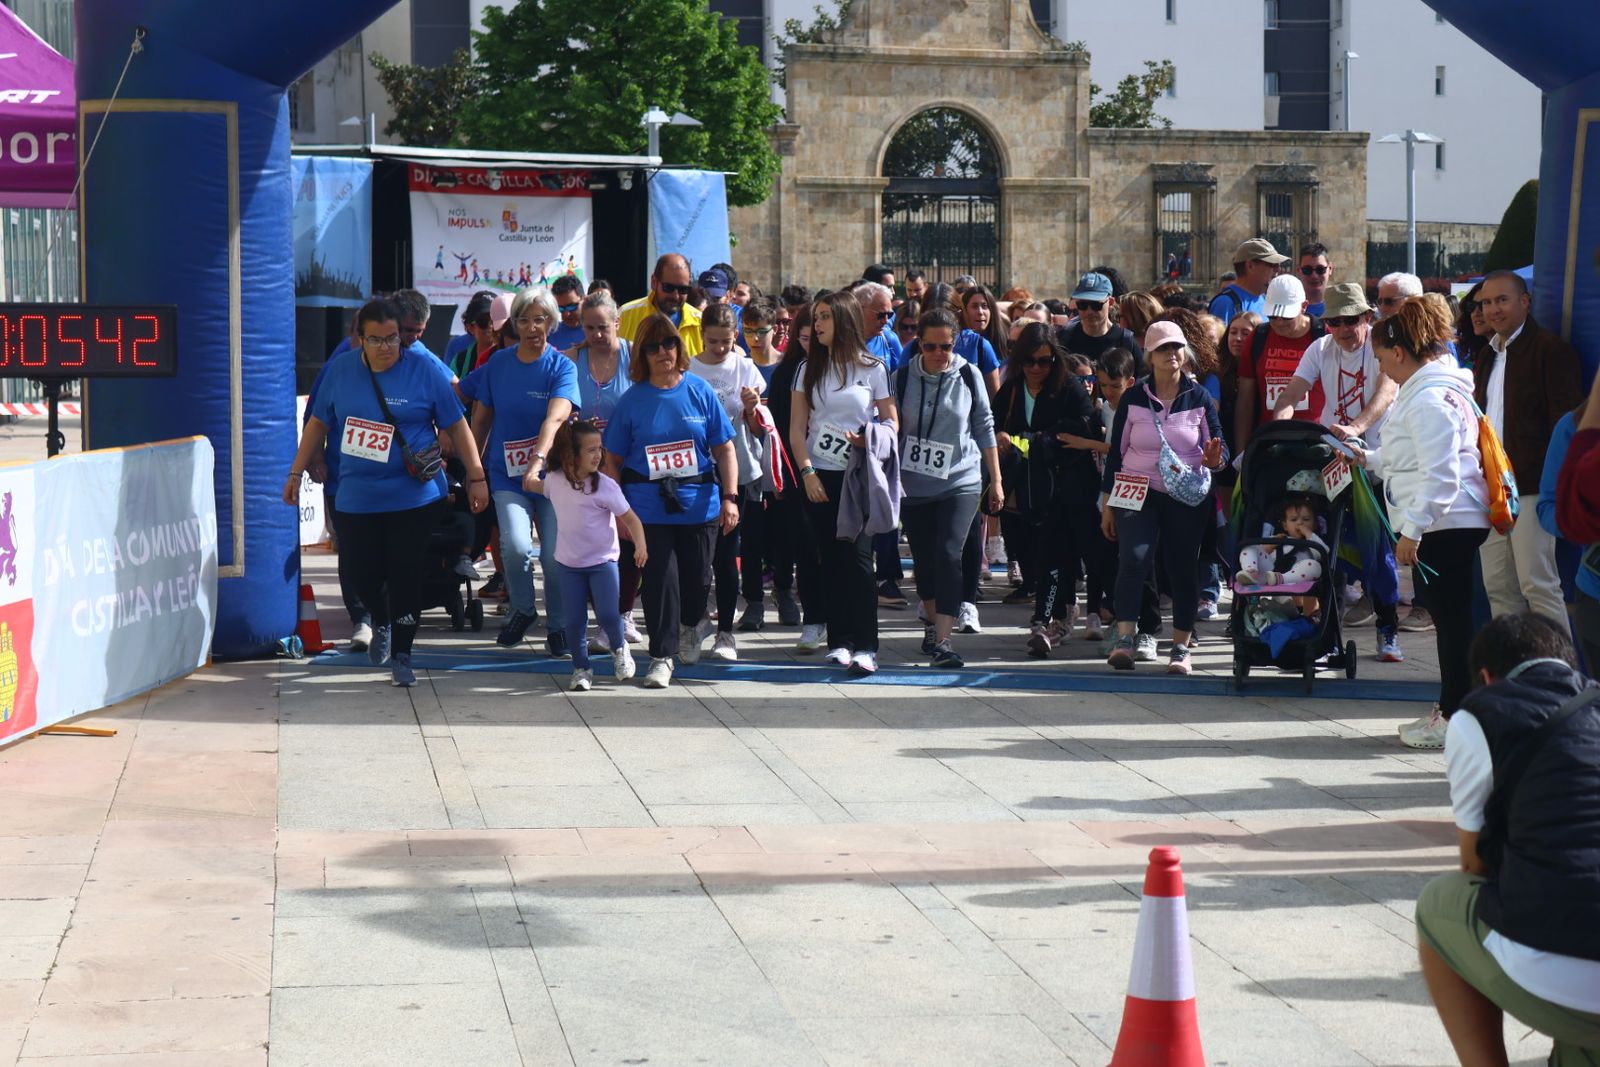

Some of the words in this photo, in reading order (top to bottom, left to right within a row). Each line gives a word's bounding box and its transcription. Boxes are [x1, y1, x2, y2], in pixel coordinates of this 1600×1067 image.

[0, 131, 75, 164] or
[448, 208, 466, 217] NOS
[499, 233, 527, 242] Castilla
[528, 235, 534, 245] y
[535, 233, 554, 242] León
[520, 224, 544, 233] Junta
[545, 224, 554, 233] de
[346, 428, 390, 452] 1123
[651, 450, 694, 471] 1181
[910, 444, 945, 468] 813
[1326, 465, 1349, 490] 1274
[1115, 483, 1146, 501] 1275
[43, 532, 76, 587] DÍA
[126, 512, 216, 567] COMUNIDAD
[71, 585, 152, 637] CASTILLA
[153, 581, 164, 616] Y
[168, 562, 199, 613] LEÓ
[1045, 584, 1058, 617] adidas
